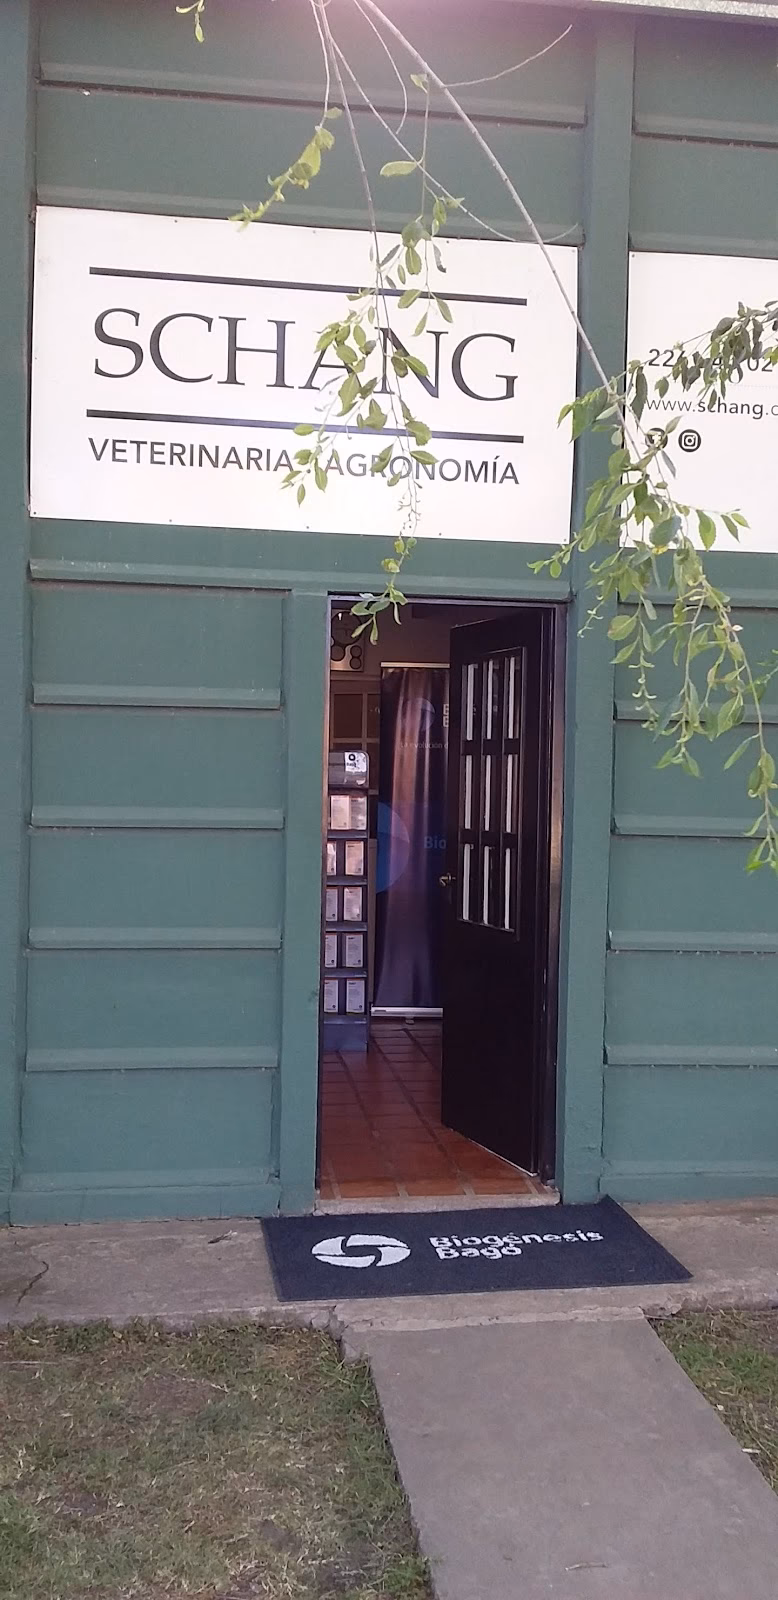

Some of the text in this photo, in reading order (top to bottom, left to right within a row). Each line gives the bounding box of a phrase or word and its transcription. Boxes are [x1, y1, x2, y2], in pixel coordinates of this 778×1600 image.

[94, 308, 517, 402] SCHANG
[88, 437, 294, 472] VETERINARIA
[429, 1230, 604, 1248] Biogénesis
[435, 1244, 523, 1260] Bagó
